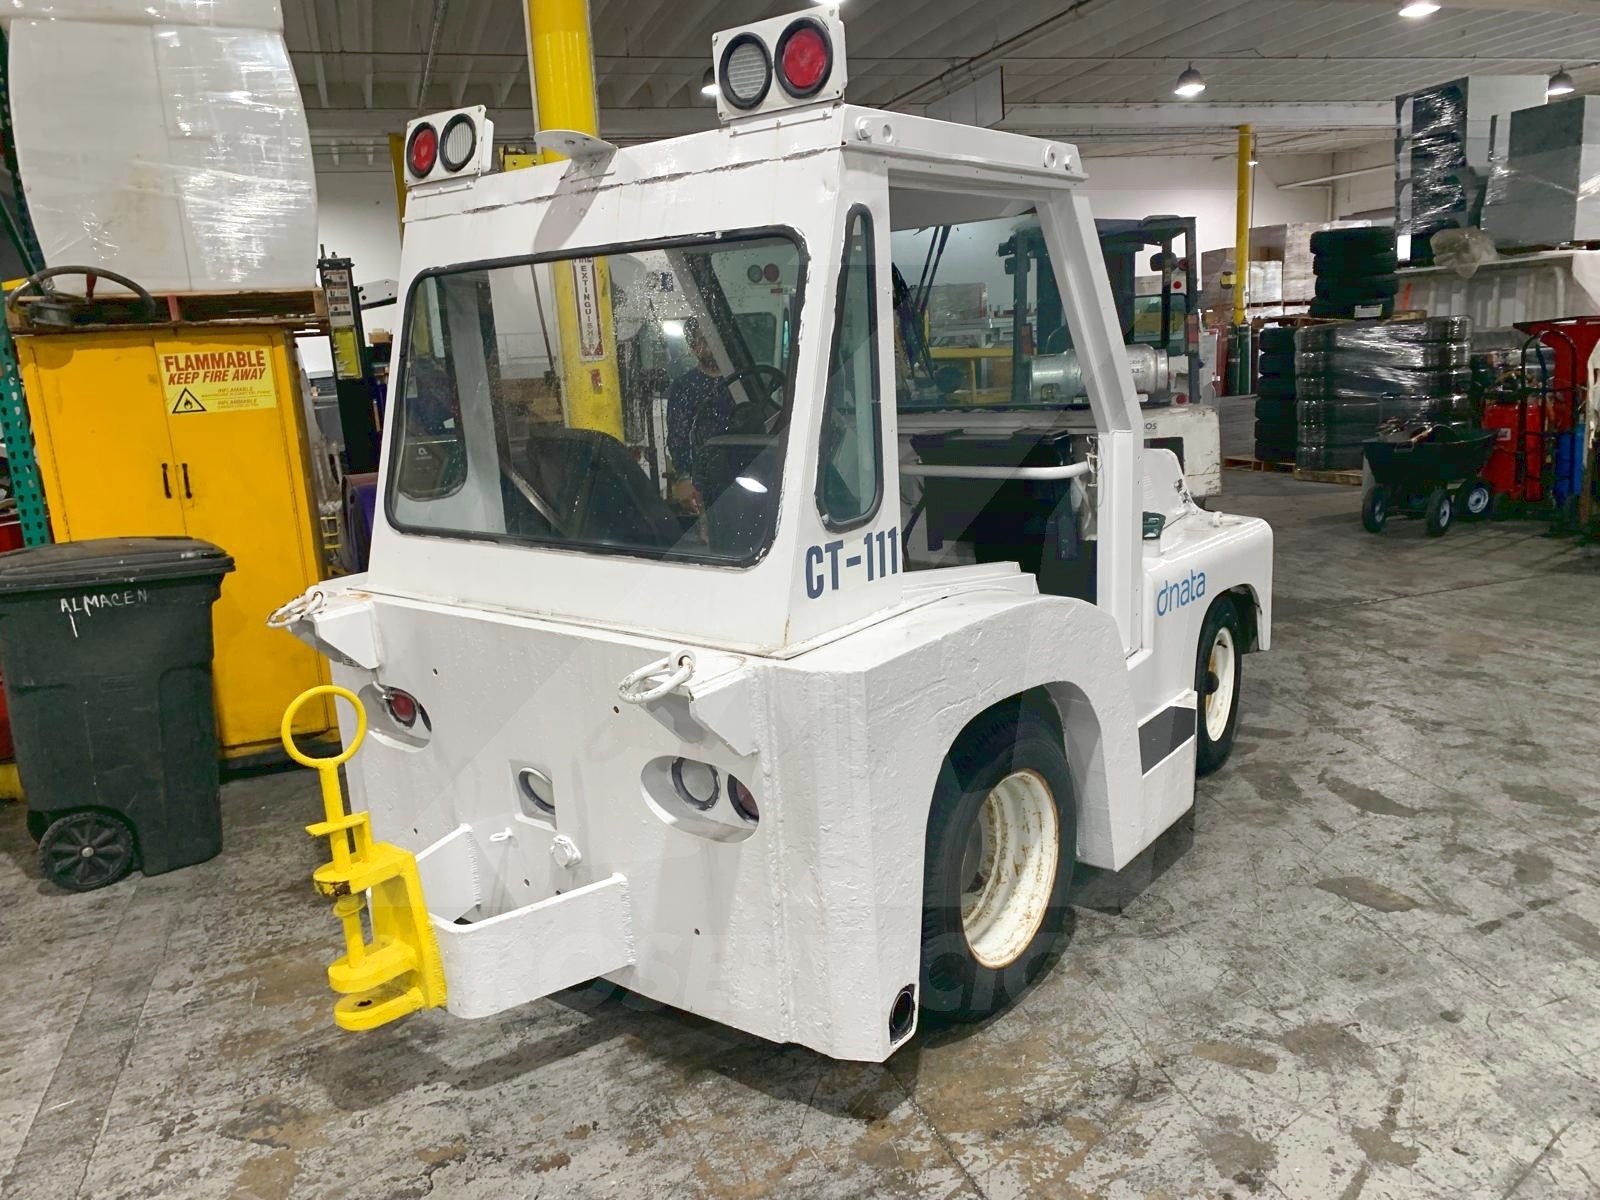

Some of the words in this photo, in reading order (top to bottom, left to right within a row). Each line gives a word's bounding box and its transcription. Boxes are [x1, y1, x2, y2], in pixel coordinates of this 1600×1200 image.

[164, 350, 266, 372] FLAMMABLE
[168, 371, 200, 386] KEEP
[202, 369, 230, 384] FIRE
[232, 367, 266, 382] AWAY
[805, 526, 898, 599] CT-111
[60, 588, 148, 617] ALMACEN
[1156, 569, 1206, 617] dnata
